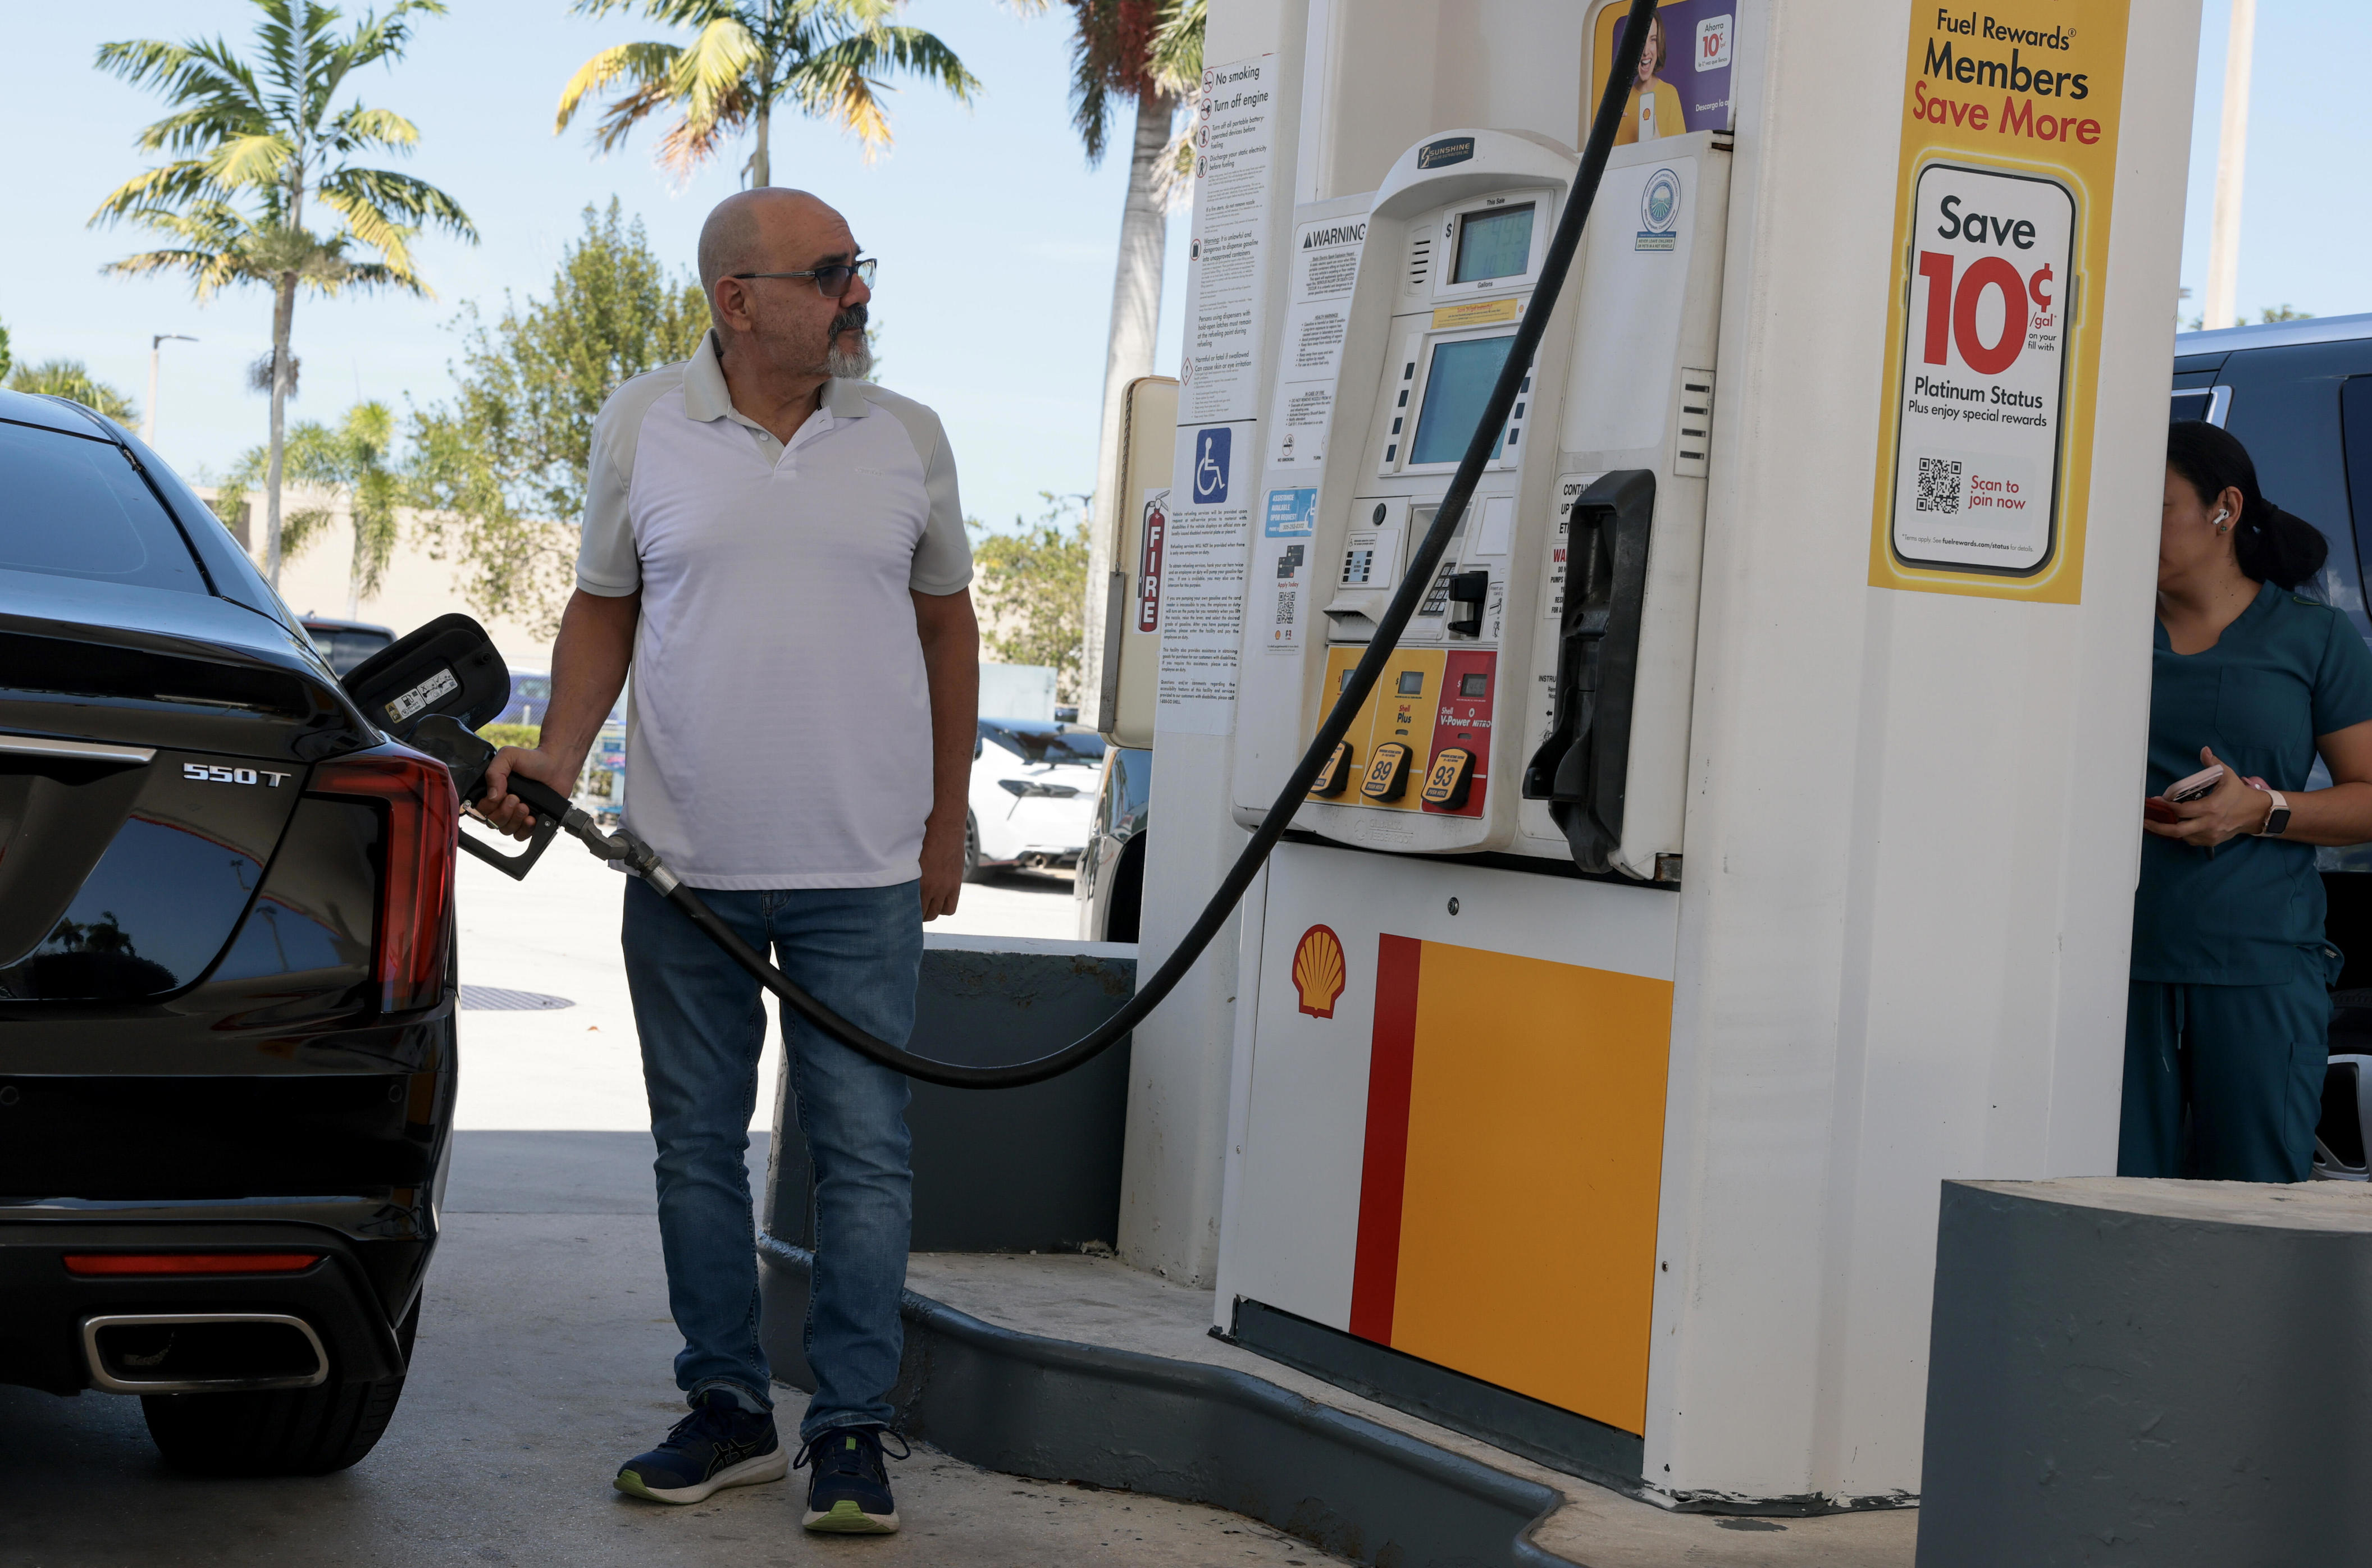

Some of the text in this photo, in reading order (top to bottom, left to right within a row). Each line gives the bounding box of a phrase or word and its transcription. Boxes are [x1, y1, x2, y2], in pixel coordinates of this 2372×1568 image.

[1704, 22, 1724, 33] Ahorra
[1937, 8, 1977, 36] Fuel
[1216, 66, 1260, 85] No smoking
[1923, 37, 2088, 100] Members
[1214, 90, 1269, 112] Turn off engine
[1696, 102, 1718, 111] Descarga
[1719, 99, 1723, 107] la
[1913, 80, 2101, 145] Save More
[1232, 117, 1248, 128] portable
[1211, 131, 1228, 140] operated
[1210, 153, 1228, 162] Discharge
[1248, 145, 1267, 154] electricity
[1430, 143, 1470, 157] SUNSHINE
[1937, 195, 2036, 249] Save
[1228, 231, 1244, 240] unlawful
[1313, 223, 1366, 247] WARNING
[1226, 241, 1242, 250] dispense
[1243, 239, 1258, 248] gasoline
[1210, 252, 1231, 261] unapproved
[1223, 312, 1242, 321] dispensers
[1208, 330, 1223, 338] refueling
[1235, 327, 1247, 335] during
[1229, 350, 1249, 359] swallowed
[1914, 376, 2043, 409] Platinum Status
[1909, 400, 2047, 427] Plus enjoy special rewards
[1971, 475, 2019, 493] Scan to
[1561, 504, 1570, 514] UP
[1968, 491, 2026, 510] join now
[1942, 538, 2009, 550] fuelrewards.com/status
[1143, 526, 1161, 623] FIRE
[1397, 712, 1412, 723] Plus
[1441, 715, 1470, 726] V-Power
[184, 762, 292, 787] 550 T
[1371, 760, 1392, 781] 89
[1433, 766, 1455, 787] 93
